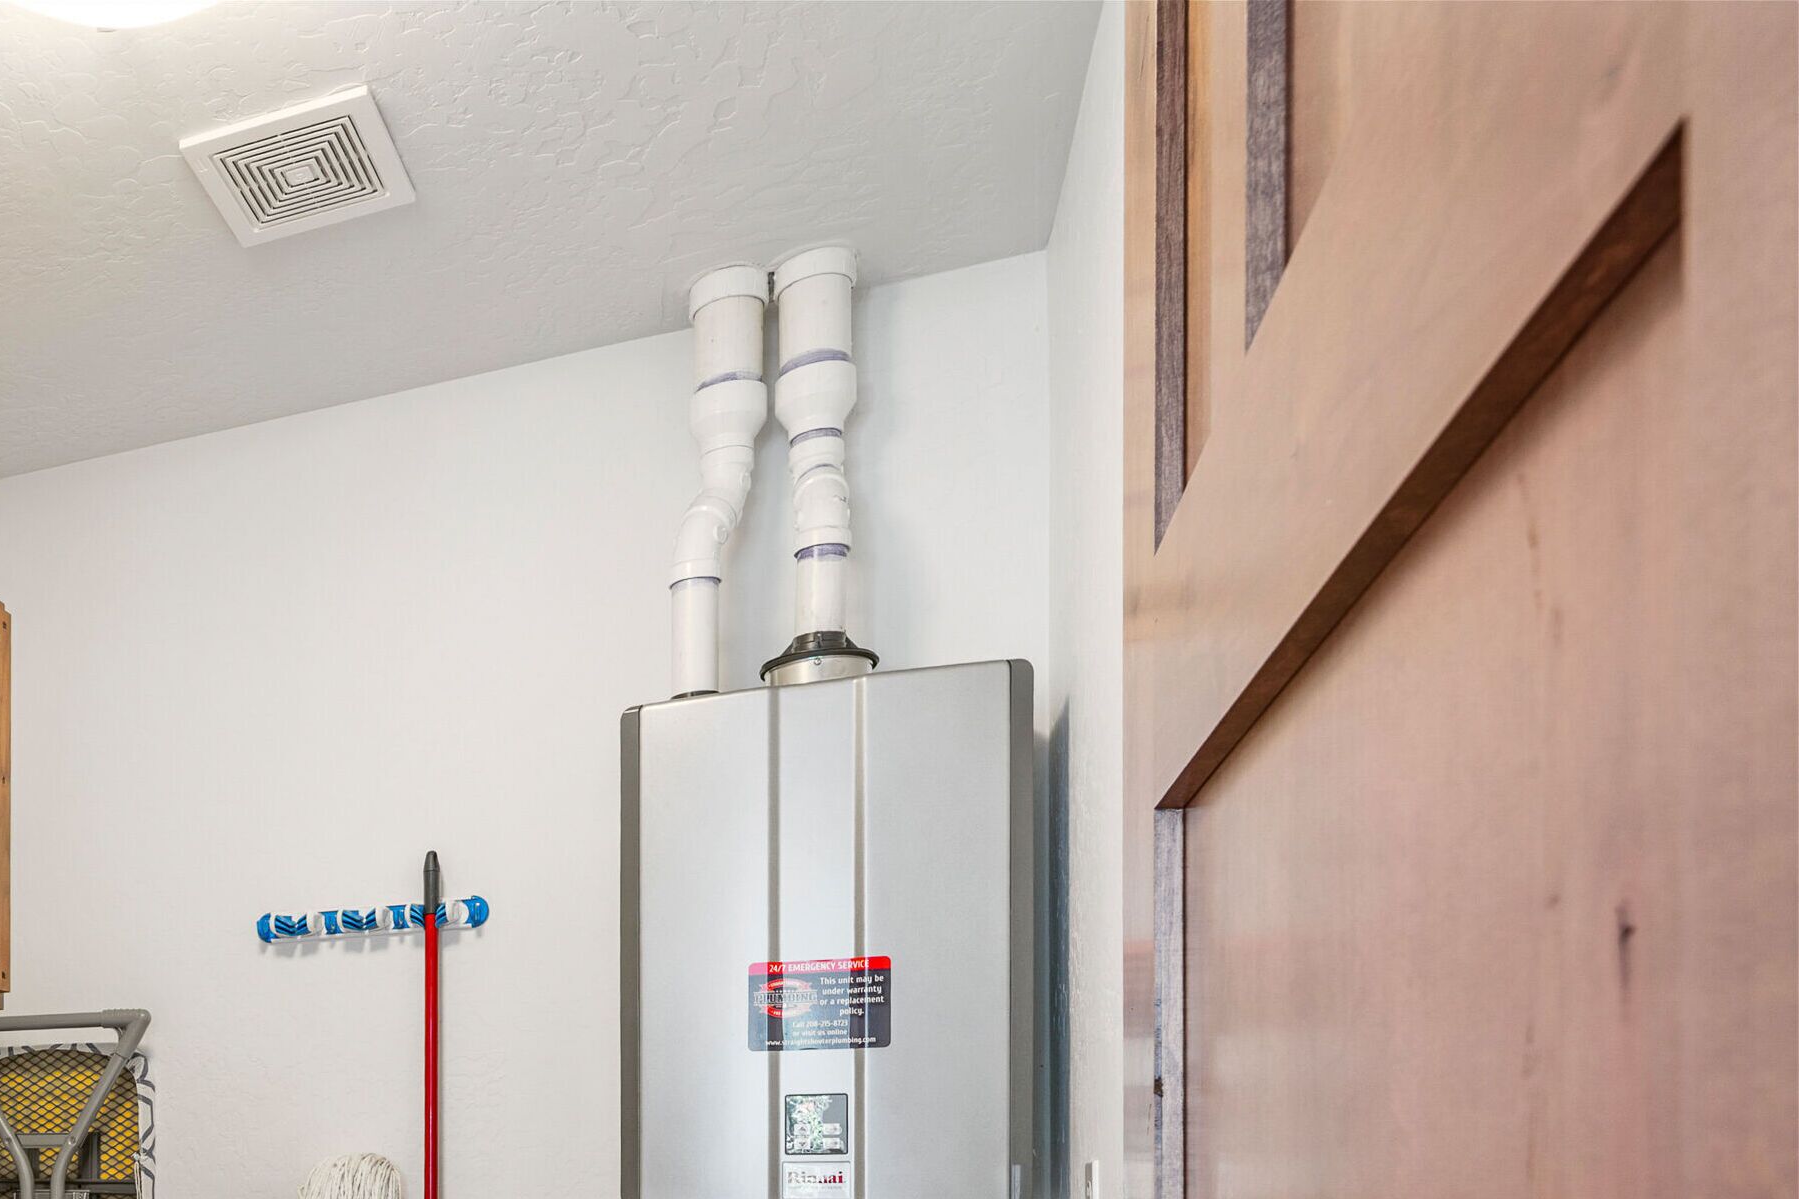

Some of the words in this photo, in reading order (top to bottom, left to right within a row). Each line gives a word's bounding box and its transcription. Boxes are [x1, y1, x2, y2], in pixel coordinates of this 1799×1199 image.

[769, 964, 786, 973] 24/7
[787, 961, 836, 972] EMERGENCY
[838, 959, 870, 970] SERVICE
[820, 976, 836, 985] This
[838, 975, 854, 984] unit
[856, 975, 872, 985] may
[874, 974, 884, 982] be
[822, 987, 845, 995] under
[847, 985, 882, 995] warranty
[836, 996, 884, 1006] replacement
[839, 1007, 865, 1016] policy.
